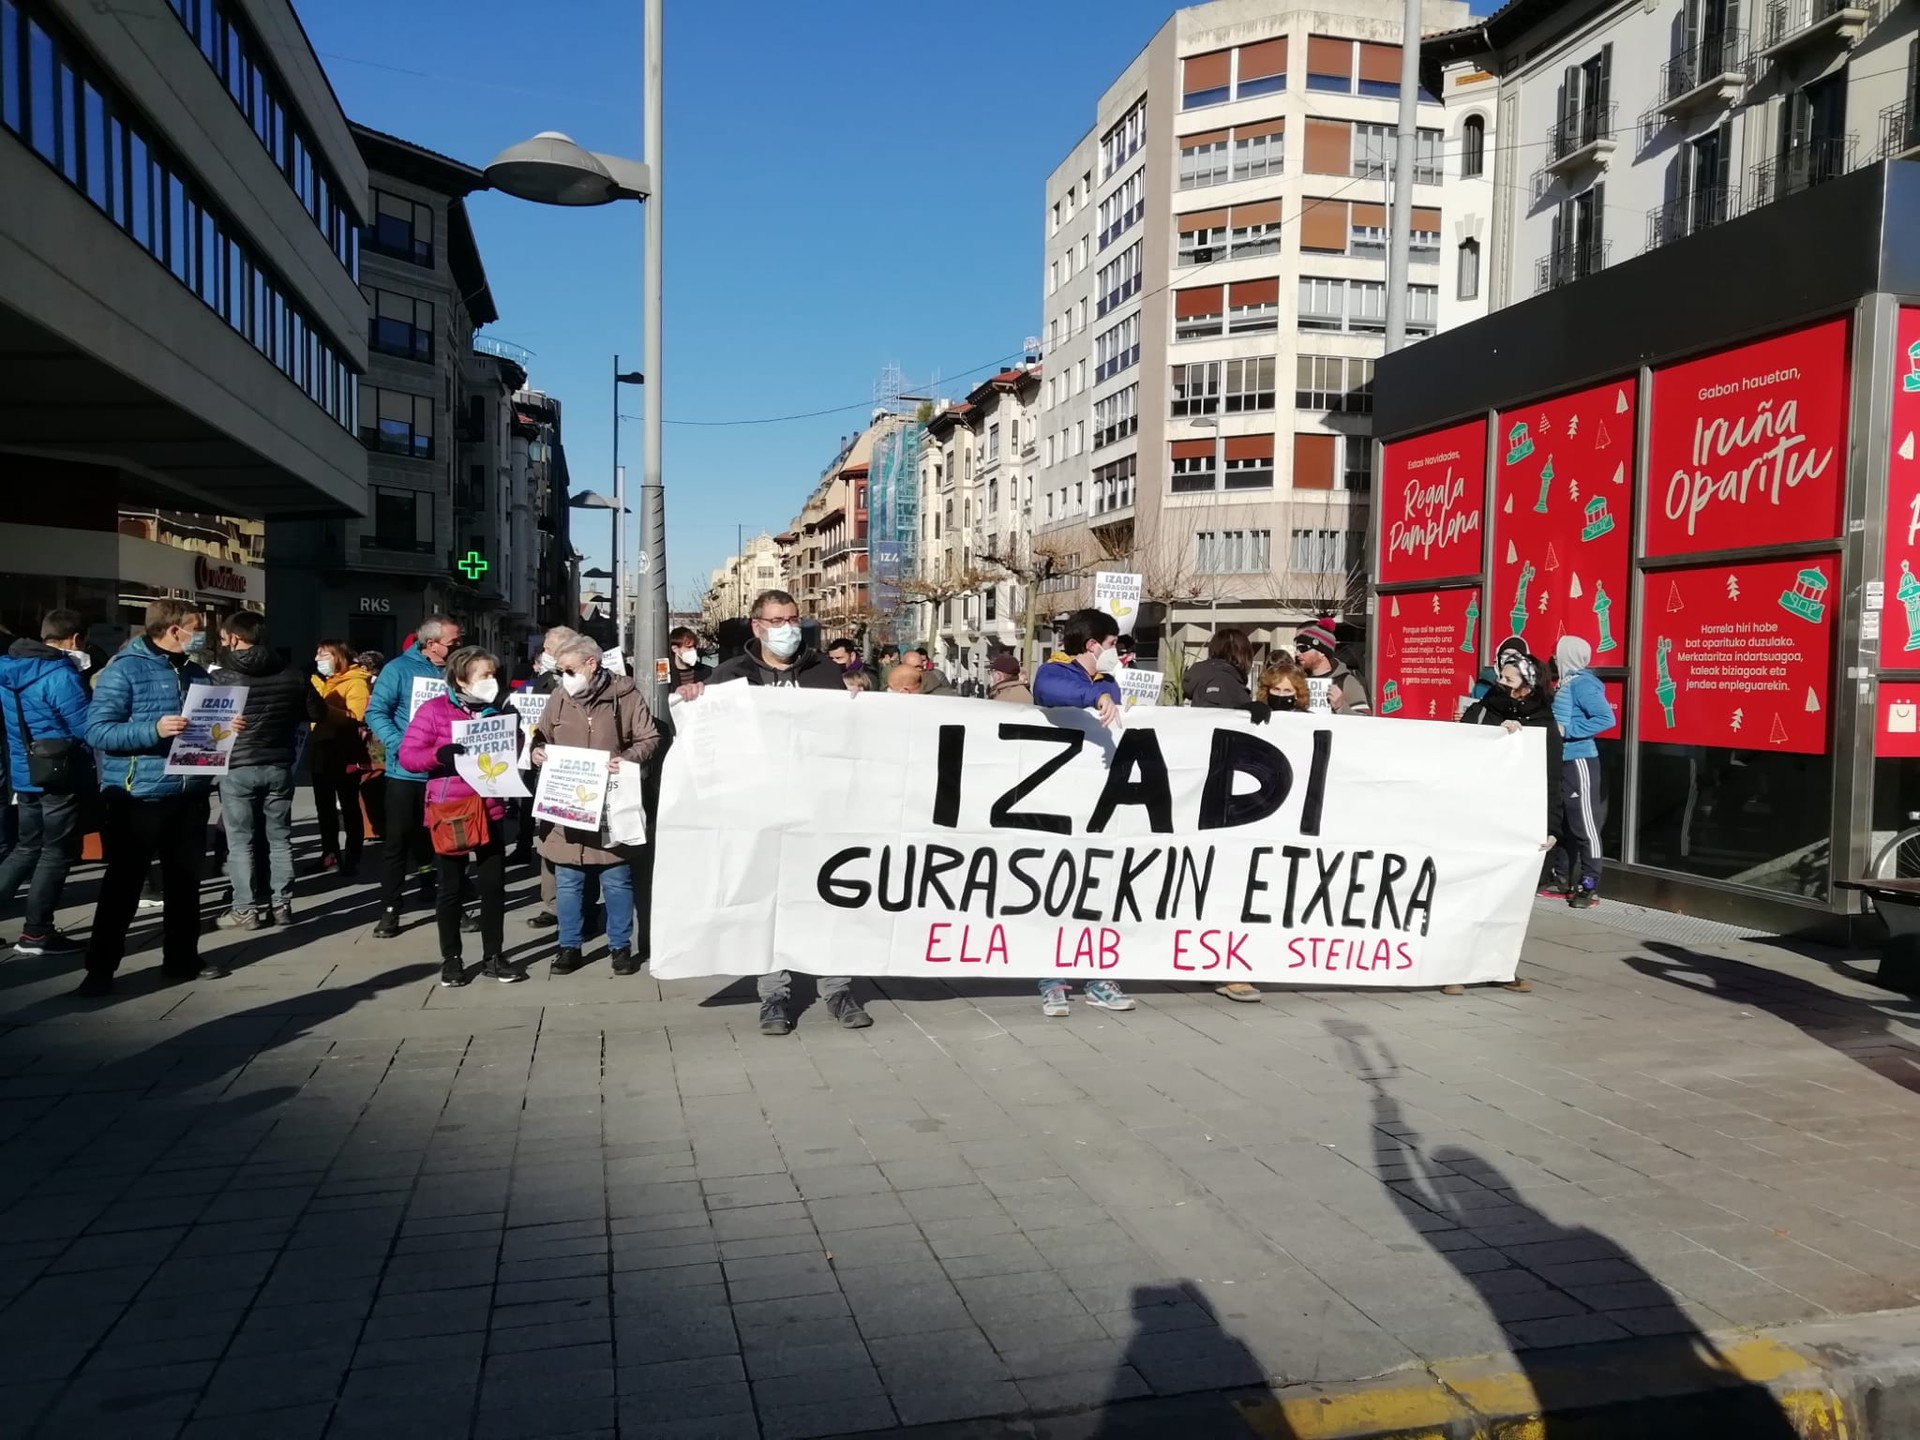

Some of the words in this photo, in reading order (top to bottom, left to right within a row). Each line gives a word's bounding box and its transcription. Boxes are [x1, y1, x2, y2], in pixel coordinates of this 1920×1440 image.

[1698, 380, 1739, 401] Gabon
[1742, 367, 1801, 391] hauetan,
[1692, 398, 1797, 467] Iruña
[1407, 459, 1424, 470] Estas
[1424, 450, 1461, 466] Navidades,
[1665, 434, 1833, 536] Oparitu
[1403, 465, 1464, 521] Regala
[1388, 505, 1479, 563] Pamplona
[1105, 574, 1134, 585] IZADI
[1097, 590, 1139, 600] ETXERA!
[360, 597, 390, 612] RKS
[1701, 624, 1734, 634] Horrela
[1735, 622, 1751, 633] hiri
[1752, 622, 1778, 633] hobe
[1685, 638, 1701, 648] bat
[1702, 637, 1746, 650] oparituko
[1747, 636, 1795, 648] duzulako.
[1677, 651, 1733, 662] Merkataritza
[1734, 651, 1804, 664] indartsuagoa,
[1690, 665, 1720, 676] kaleak
[1721, 665, 1768, 679] biziagoak
[1769, 666, 1787, 676] eta
[426, 680, 447, 692] IZA
[1121, 681, 1160, 690] URASOEKIN
[1685, 679, 1717, 692] jendea
[1718, 679, 1791, 693] enpleguarekin.
[1122, 687, 1158, 700] TXERA!
[201, 697, 235, 709] IZADI
[520, 696, 548, 707] IZAD
[466, 719, 505, 735] IZADI
[455, 729, 515, 744] GURASOEKIN
[465, 739, 515, 756] TXERA!
[559, 758, 596, 772] IZADI
[932, 722, 1333, 836] IZADI
[816, 844, 1214, 920] GURASOEKIN
[1241, 845, 1437, 936] ETXERA
[925, 923, 1009, 964] ELA
[1055, 926, 1120, 968] LAB
[1173, 929, 1252, 971] ESK
[1287, 936, 1414, 971] STEILAS
